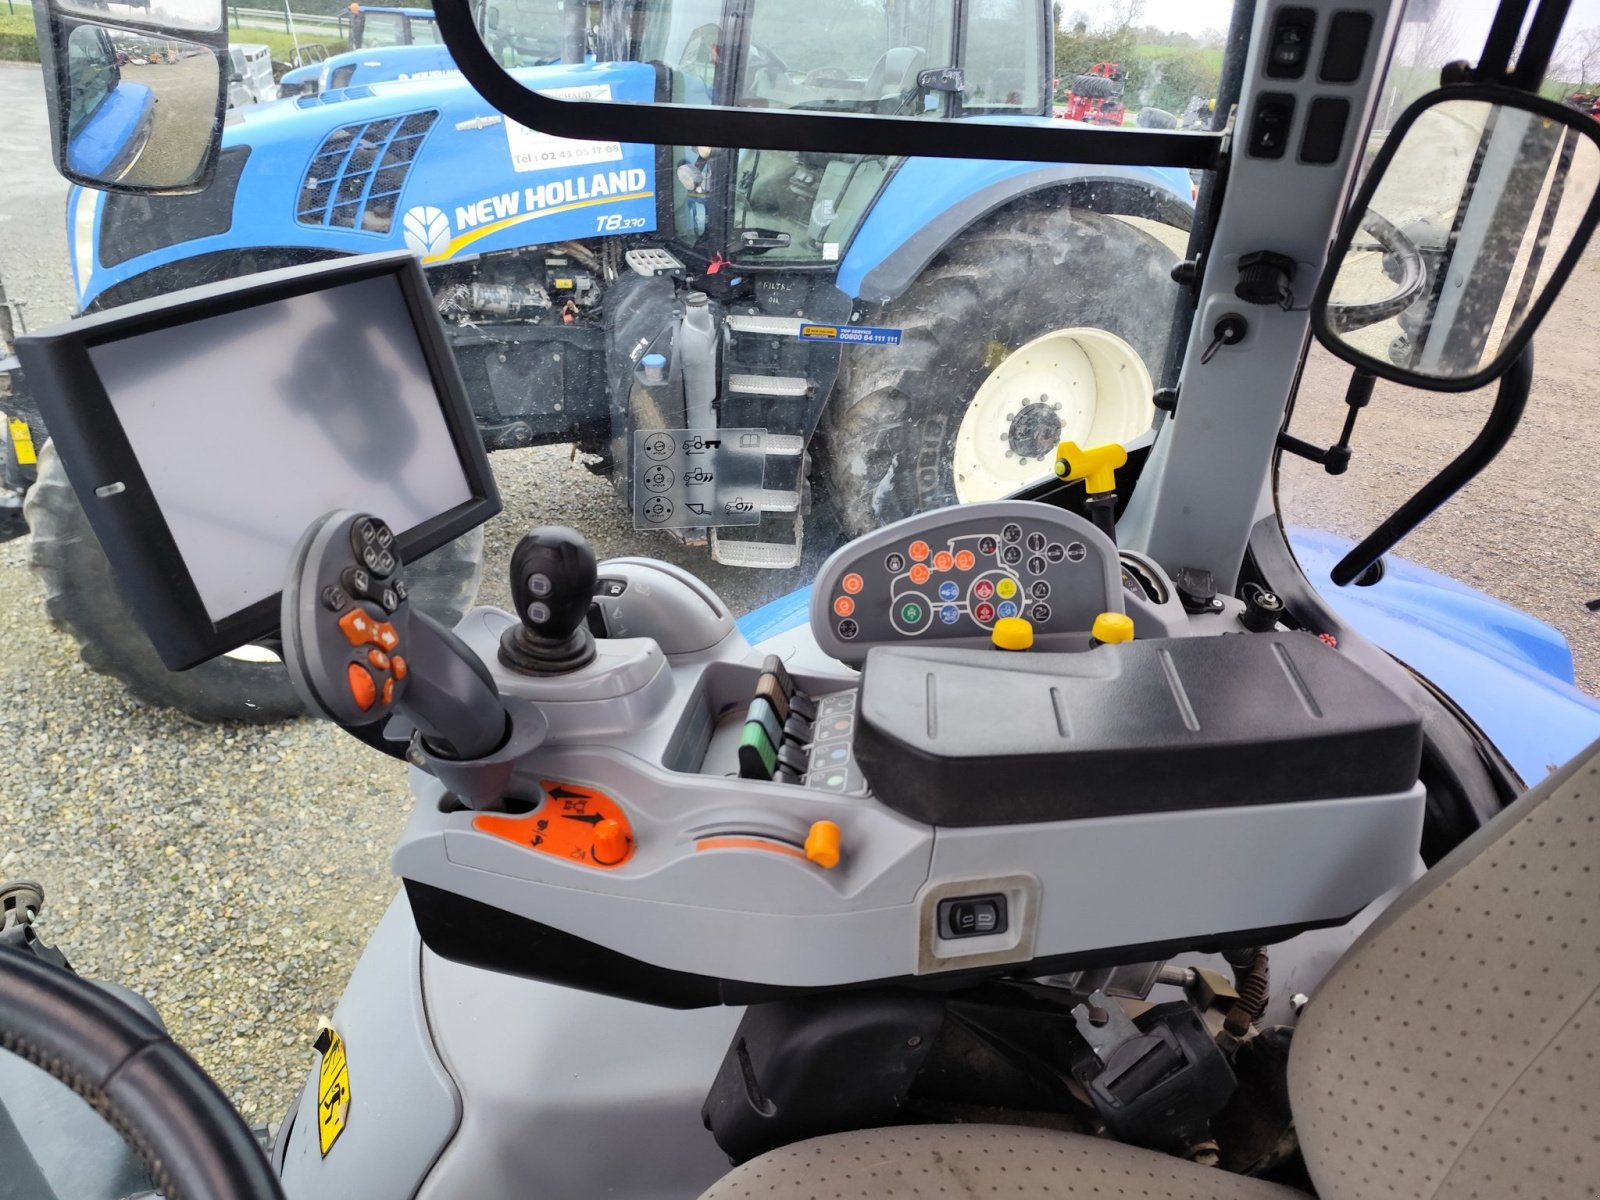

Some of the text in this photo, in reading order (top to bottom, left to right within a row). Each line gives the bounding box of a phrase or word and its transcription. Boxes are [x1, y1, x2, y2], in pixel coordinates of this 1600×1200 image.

[541, 152, 557, 162] 02
[559, 150, 573, 159] 43
[605, 145, 620, 154] 08
[455, 168, 646, 230] NEW HOLLAND
[839, 333, 863, 341] 00800
